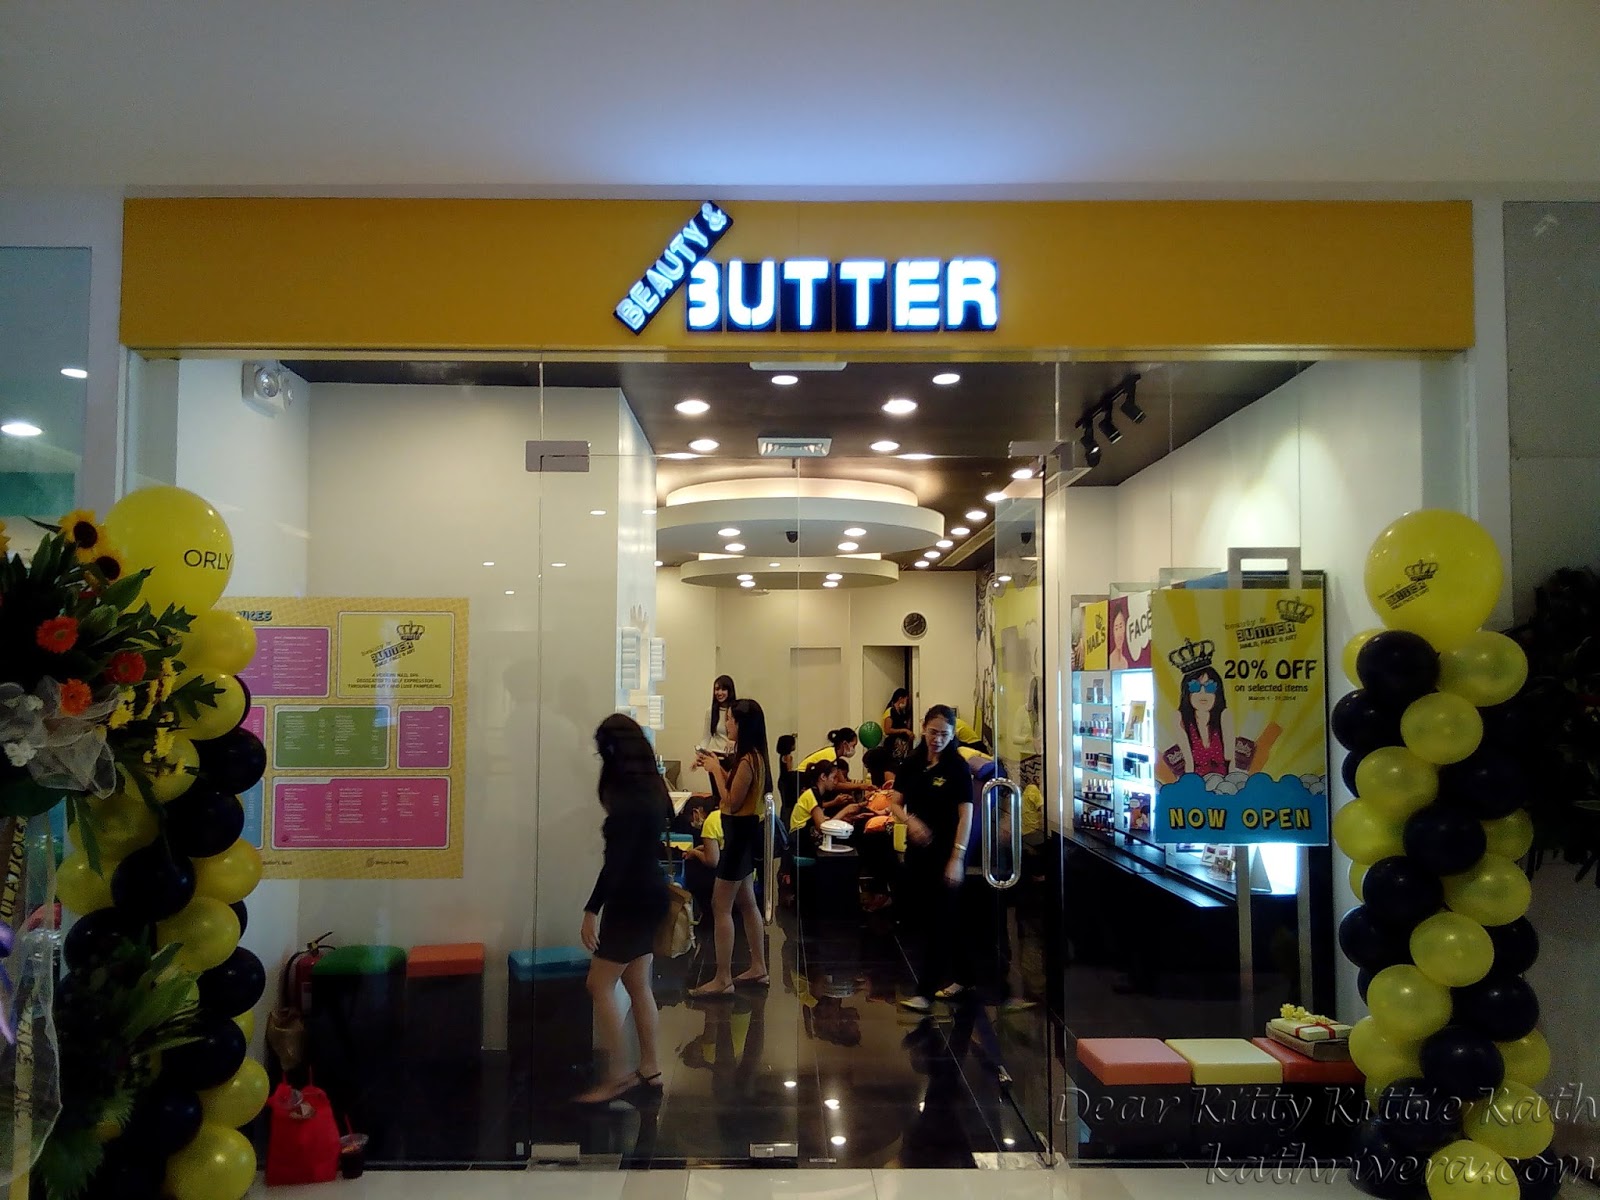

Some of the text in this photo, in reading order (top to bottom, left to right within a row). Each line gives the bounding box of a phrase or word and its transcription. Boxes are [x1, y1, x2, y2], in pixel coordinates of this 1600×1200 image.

[615, 201, 728, 330] BEAUTY &
[687, 257, 998, 330] BUTTER
[183, 549, 233, 571] ORLY
[1128, 608, 1152, 642] FACE
[1236, 621, 1297, 643] BUTTER
[1086, 627, 1106, 655] NAILS
[1223, 659, 1318, 680] 20% OFF
[1234, 683, 1309, 693] on selected items
[1169, 807, 1312, 830] NOW OPEN
